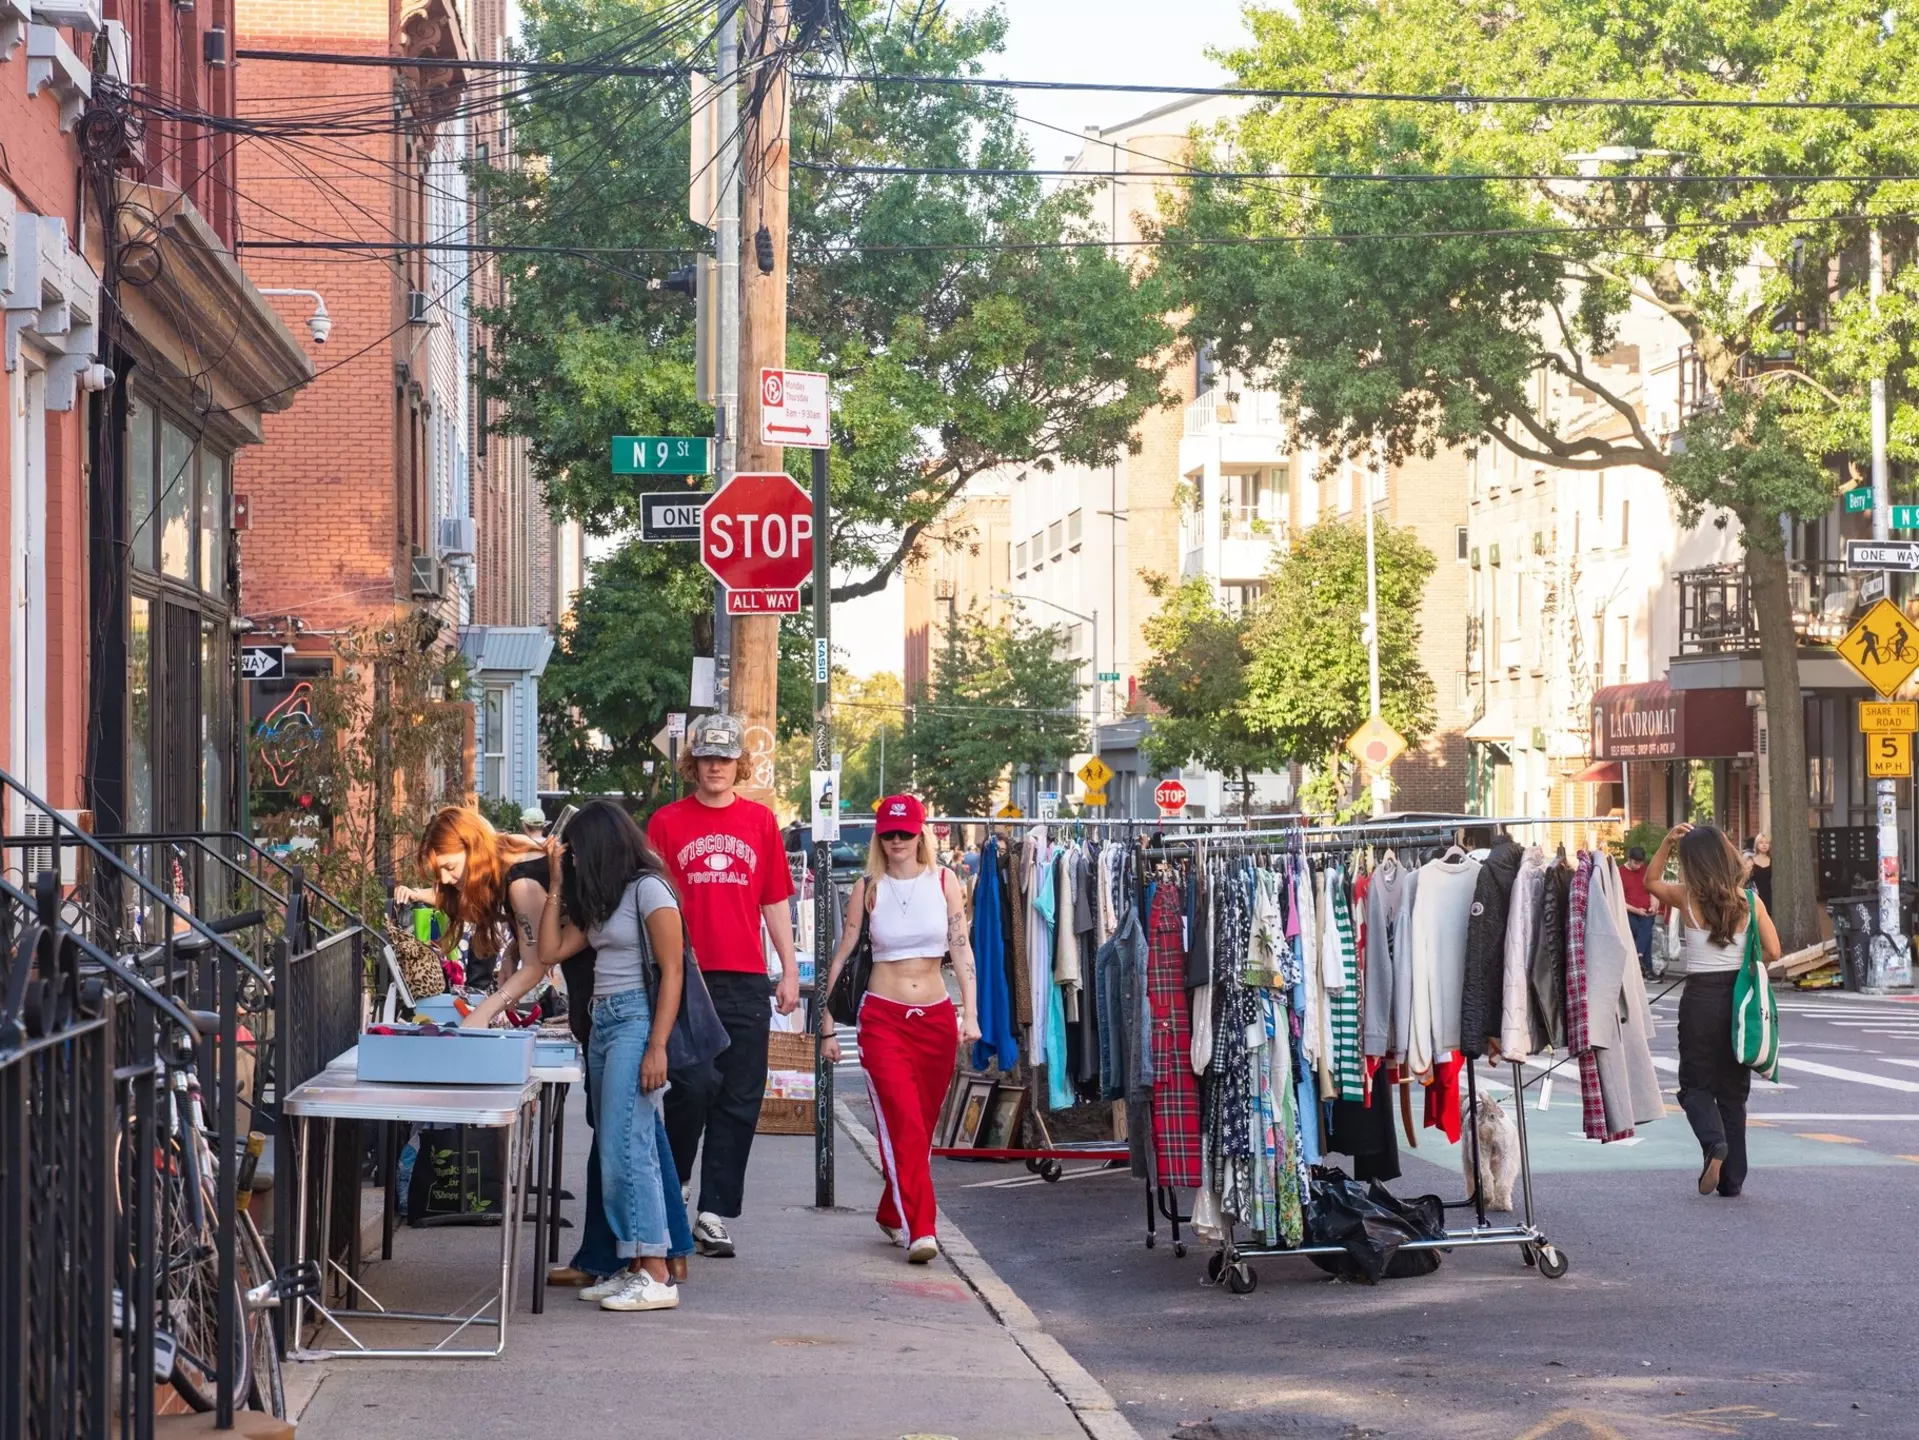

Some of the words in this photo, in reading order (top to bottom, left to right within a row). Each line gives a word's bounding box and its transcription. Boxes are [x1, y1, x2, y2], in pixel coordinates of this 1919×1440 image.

[633, 441, 646, 468] N
[656, 441, 669, 468] 9
[677, 440, 690, 457] St
[1849, 493, 1866, 511] Berry
[663, 508, 701, 525] ONE
[1902, 508, 1911, 526] N
[709, 513, 813, 559] STOP
[1860, 550, 1886, 561] ONE
[733, 594, 760, 609] ALL
[766, 593, 795, 609] WAY
[818, 640, 826, 680] KASIO
[1866, 707, 1892, 716] SHARE
[1897, 707, 1911, 716] THE
[1610, 708, 1677, 739] LAUNDROMAT
[1876, 717, 1902, 727] ROAD
[1881, 737, 1898, 758] 5
[1157, 790, 1186, 803] STOP
[1042, 810, 1054, 820] 10
[677, 834, 757, 874] WISCONSIN
[687, 871, 749, 886] FOOTBALL
